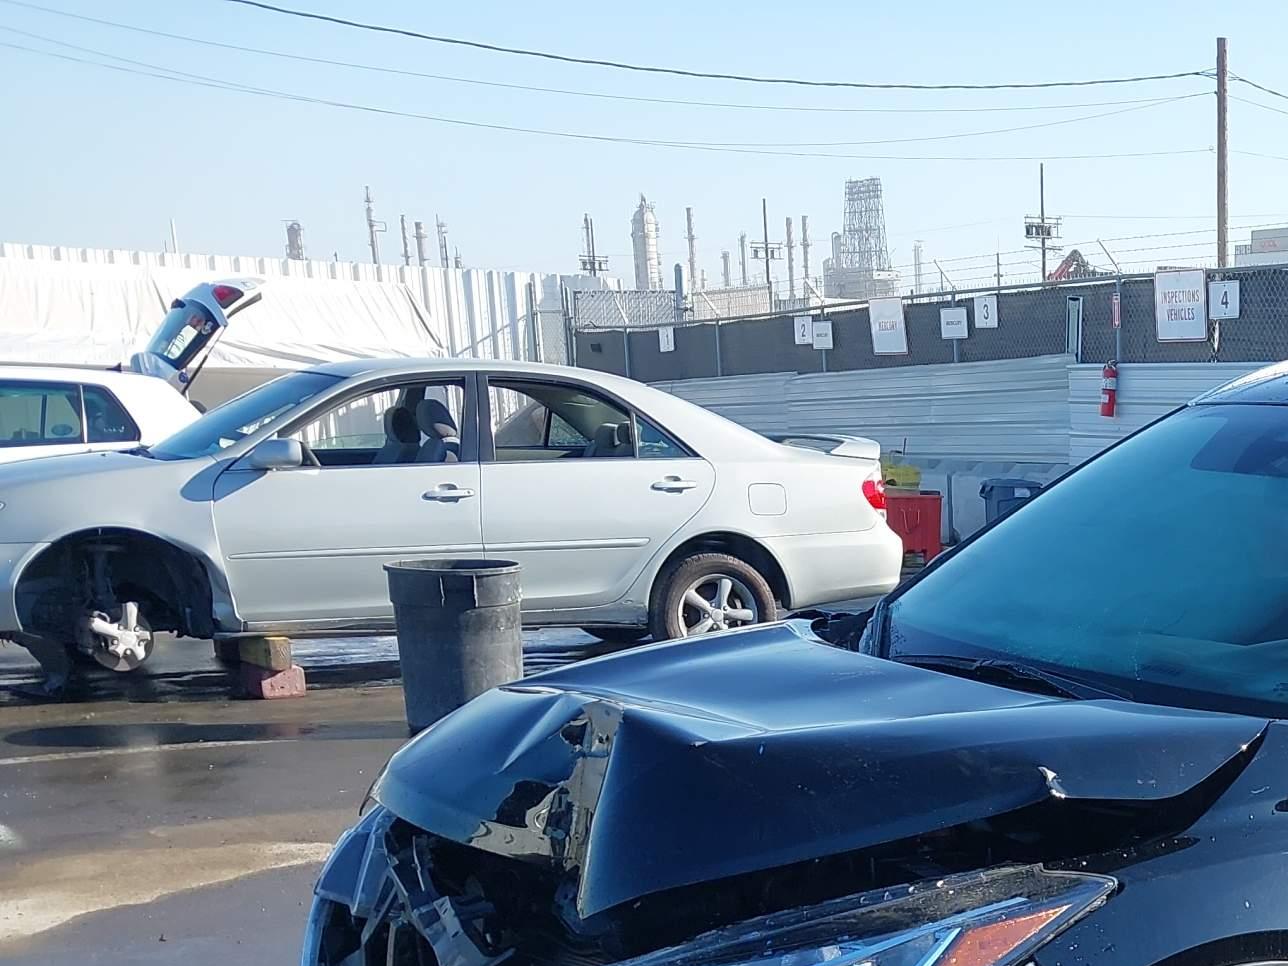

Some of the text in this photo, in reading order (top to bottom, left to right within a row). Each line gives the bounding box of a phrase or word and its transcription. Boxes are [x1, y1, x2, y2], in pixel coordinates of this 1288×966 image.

[1161, 289, 1200, 304] INSPECTIONS
[1220, 290, 1229, 309] 4
[983, 304, 990, 320] 3
[1166, 307, 1195, 321] VEHICLES
[800, 323, 807, 338] 2
